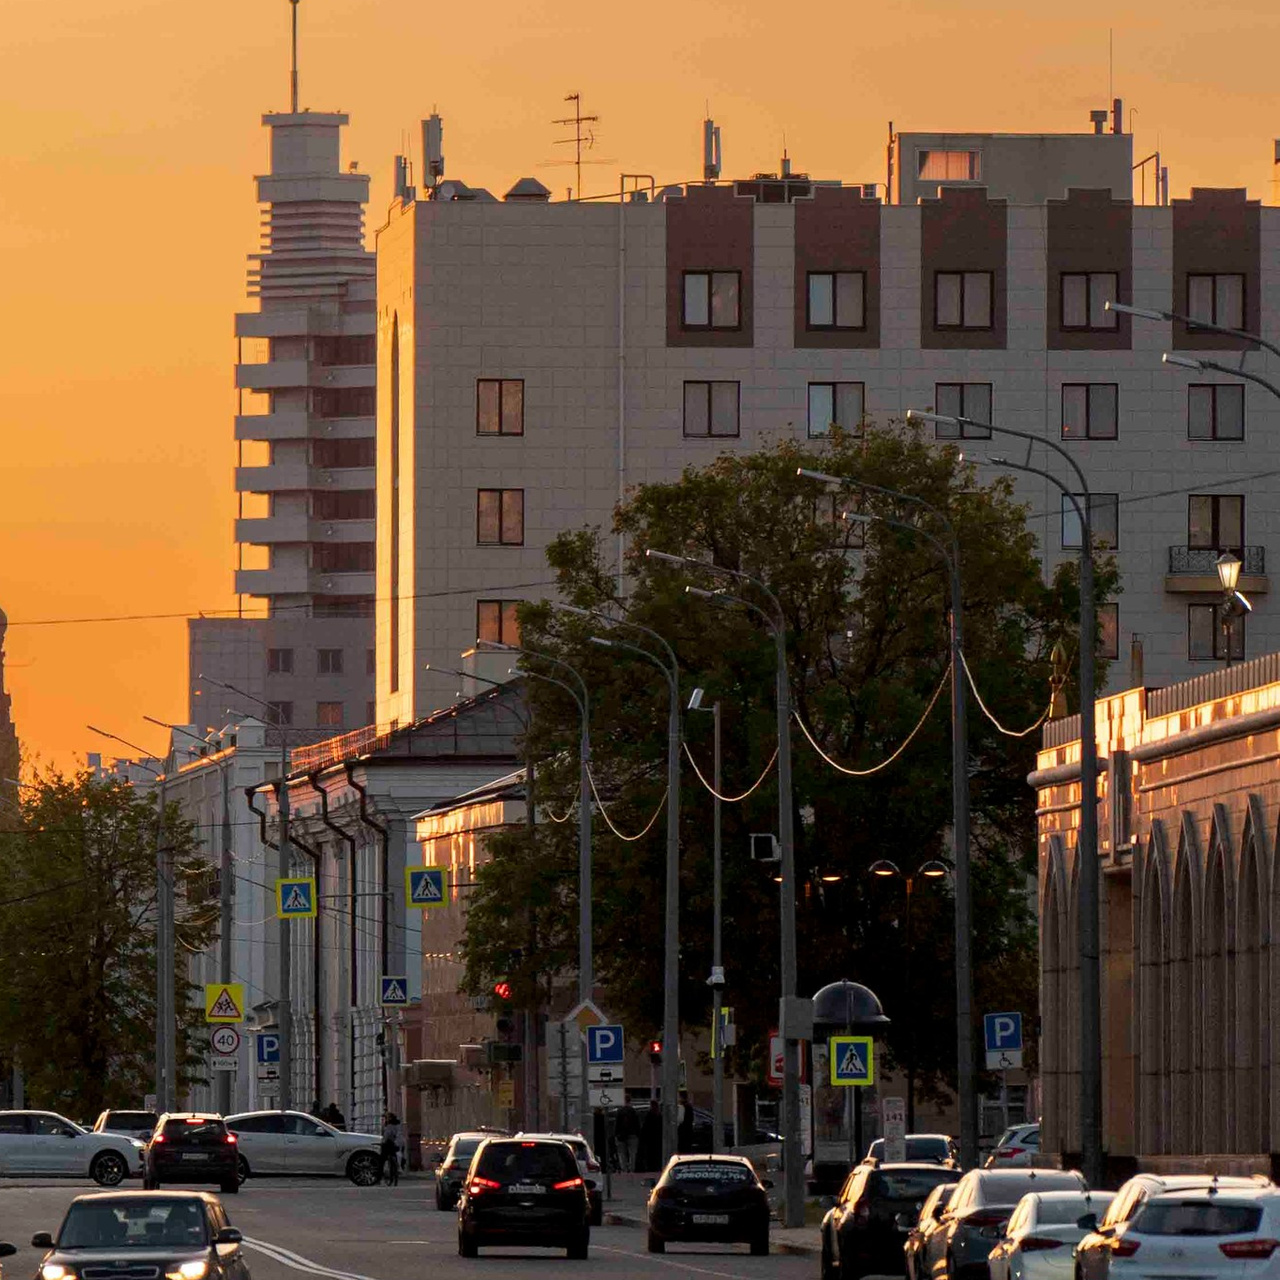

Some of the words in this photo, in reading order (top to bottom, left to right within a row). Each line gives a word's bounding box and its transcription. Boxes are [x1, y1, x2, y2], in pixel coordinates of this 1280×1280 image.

[217, 1034, 235, 1046] 40
[595, 1030, 615, 1058] P
[995, 1017, 1015, 1047] P
[263, 1036, 279, 1060] P
[885, 1113, 903, 1122] 141
